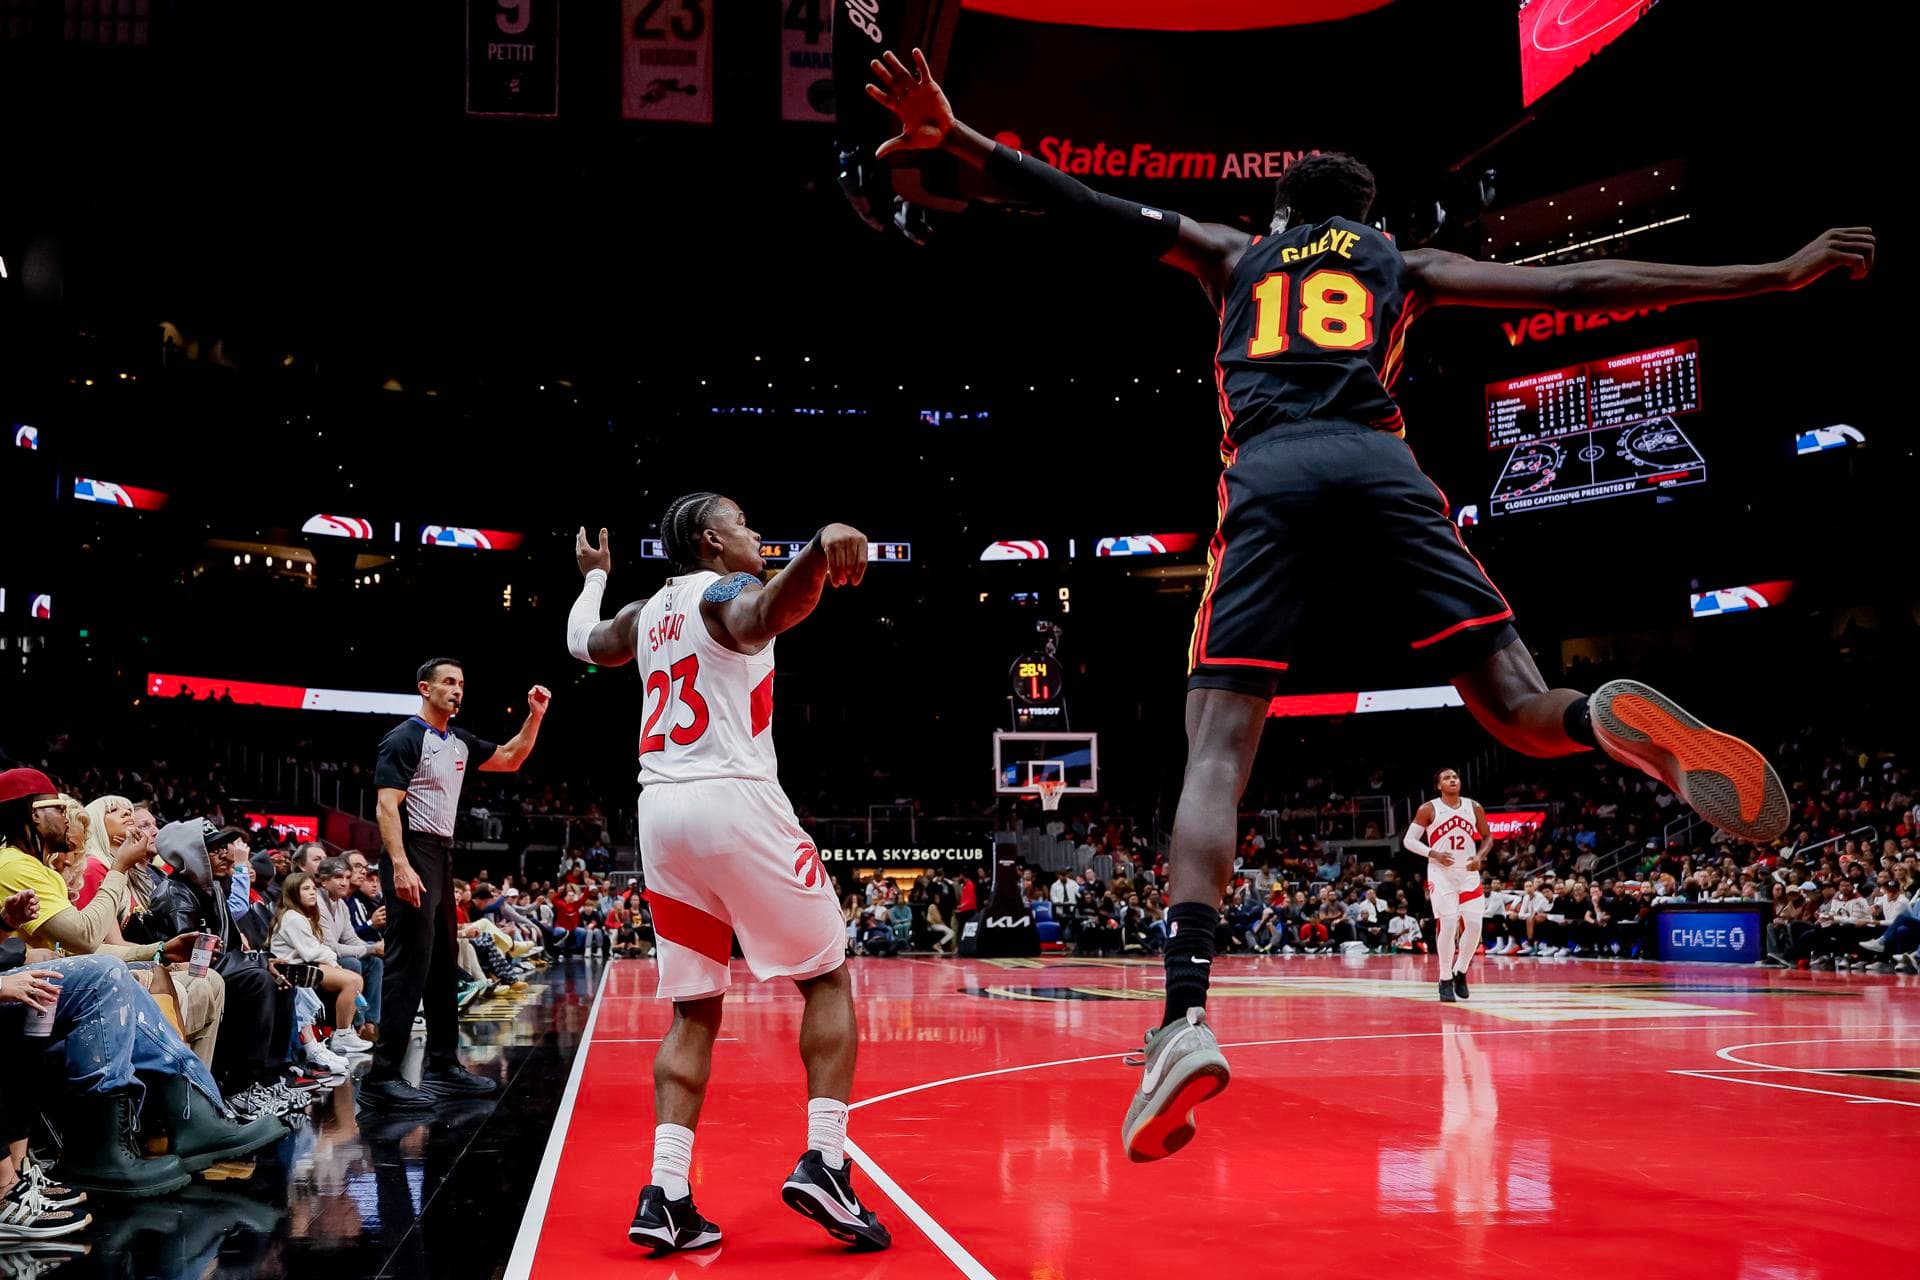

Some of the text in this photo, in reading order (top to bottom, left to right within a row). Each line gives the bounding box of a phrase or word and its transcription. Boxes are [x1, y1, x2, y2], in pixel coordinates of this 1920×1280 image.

[488, 42, 536, 63] PETTIT
[1221, 150, 1320, 179] AREN
[1248, 269, 1374, 358] 18
[1504, 482, 1636, 510] CLOSED CAPTIONING PRESENTED BY
[1018, 664, 1047, 677] 28.4
[638, 653, 710, 756] 23
[1448, 836, 1464, 850] 12
[821, 850, 877, 860] DELTA
[1672, 930, 1727, 947] CHASE
